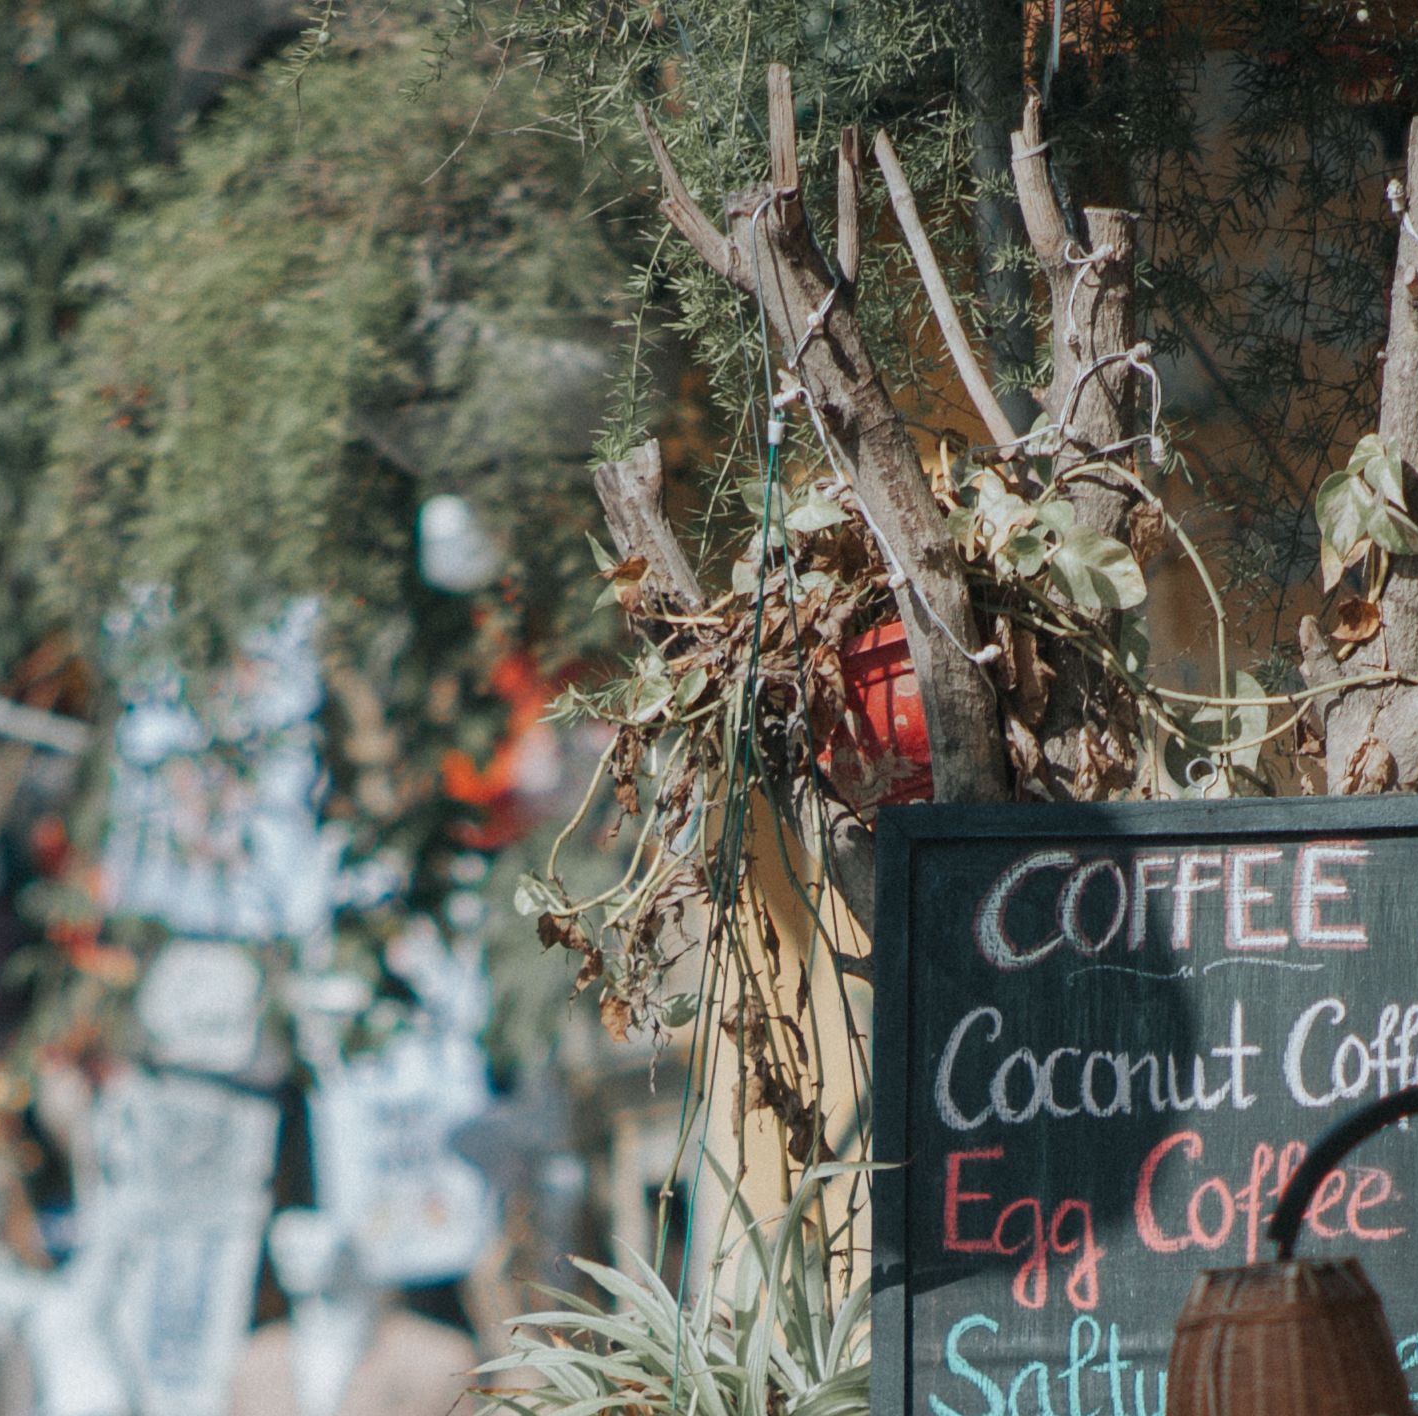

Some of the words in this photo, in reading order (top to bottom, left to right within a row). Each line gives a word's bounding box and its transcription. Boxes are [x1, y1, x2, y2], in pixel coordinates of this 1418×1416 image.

[976, 840, 1375, 971] COFFEE
[934, 999, 1261, 1131] Coconut
[942, 1146, 1106, 1310] Egg
